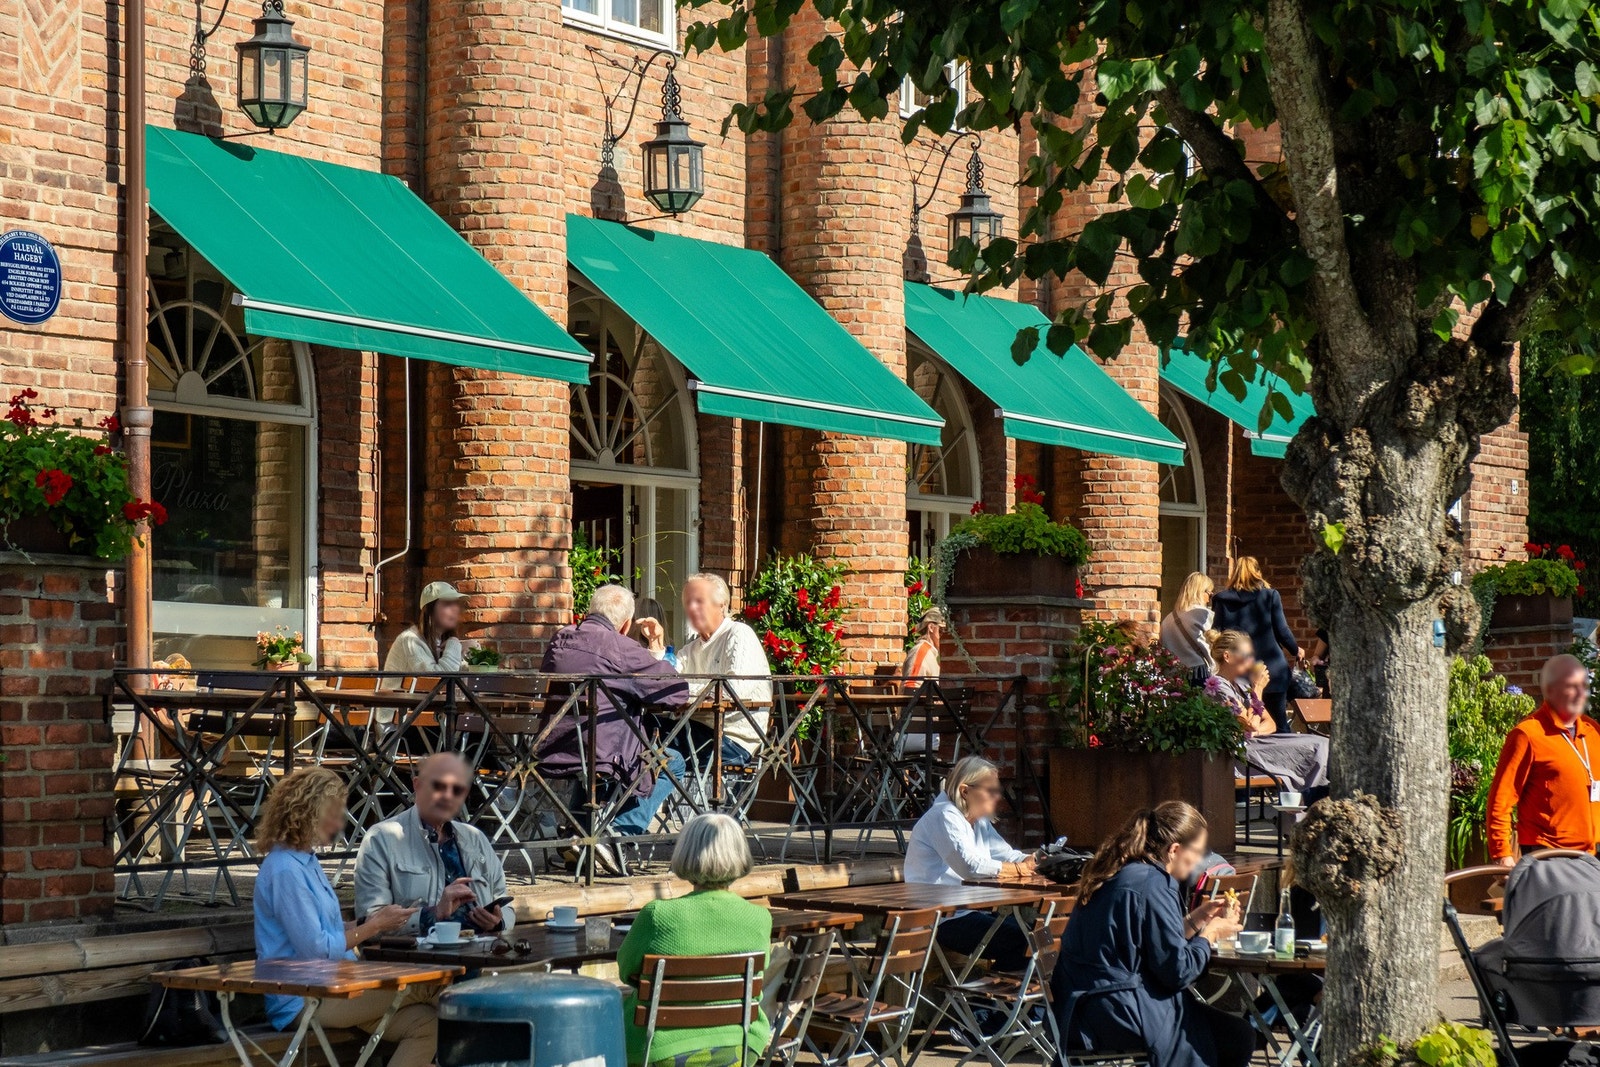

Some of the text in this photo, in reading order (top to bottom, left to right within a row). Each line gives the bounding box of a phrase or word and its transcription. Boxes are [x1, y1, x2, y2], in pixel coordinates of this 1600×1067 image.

[12, 242, 43, 255] ULLEVÅL
[14, 252, 43, 264] HAGEBY
[152, 460, 230, 512] Plaza
